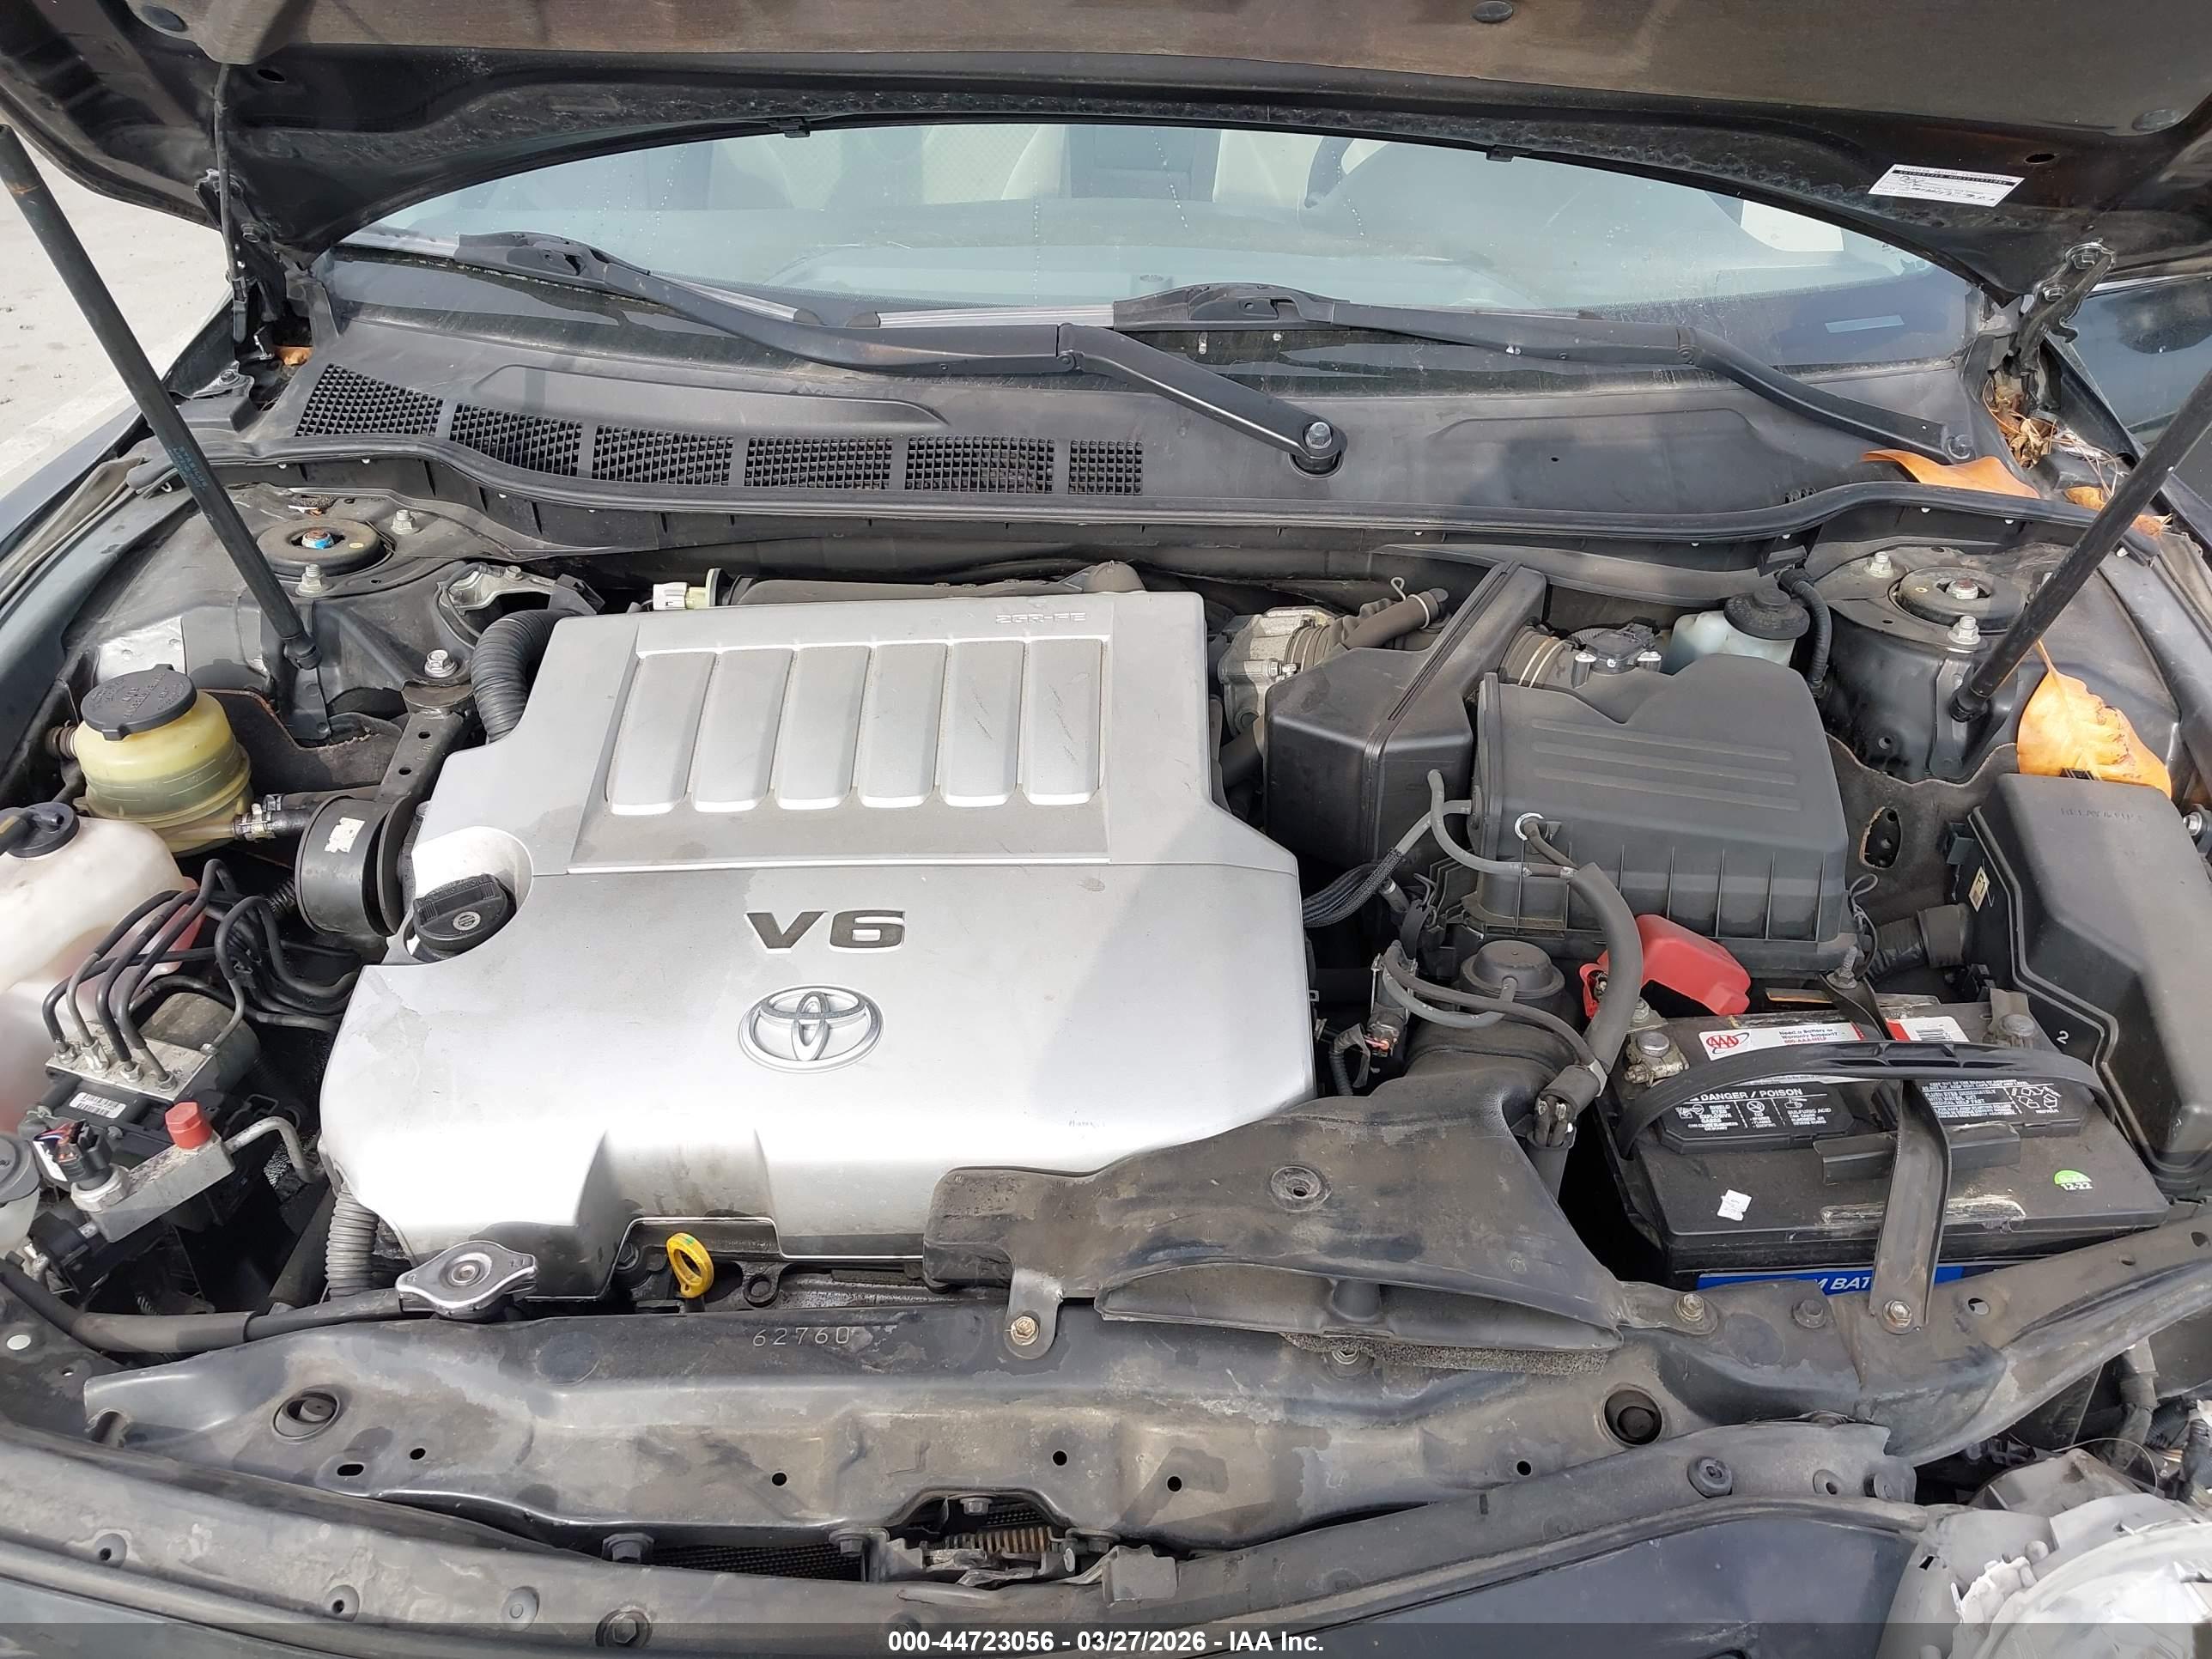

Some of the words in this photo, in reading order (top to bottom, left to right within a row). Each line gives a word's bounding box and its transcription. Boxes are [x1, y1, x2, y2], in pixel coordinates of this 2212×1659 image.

[995, 612, 1086, 624] 2GR-FE
[745, 909, 906, 951] V6
[1707, 1034, 1738, 1048] AAA
[2056, 1030, 2070, 1045] 2
[1700, 1091, 1748, 1102] DANGER
[1759, 1087, 1803, 1097] POISON
[2061, 1182, 2094, 1191] 12-22
[752, 1326, 850, 1346] 62760
